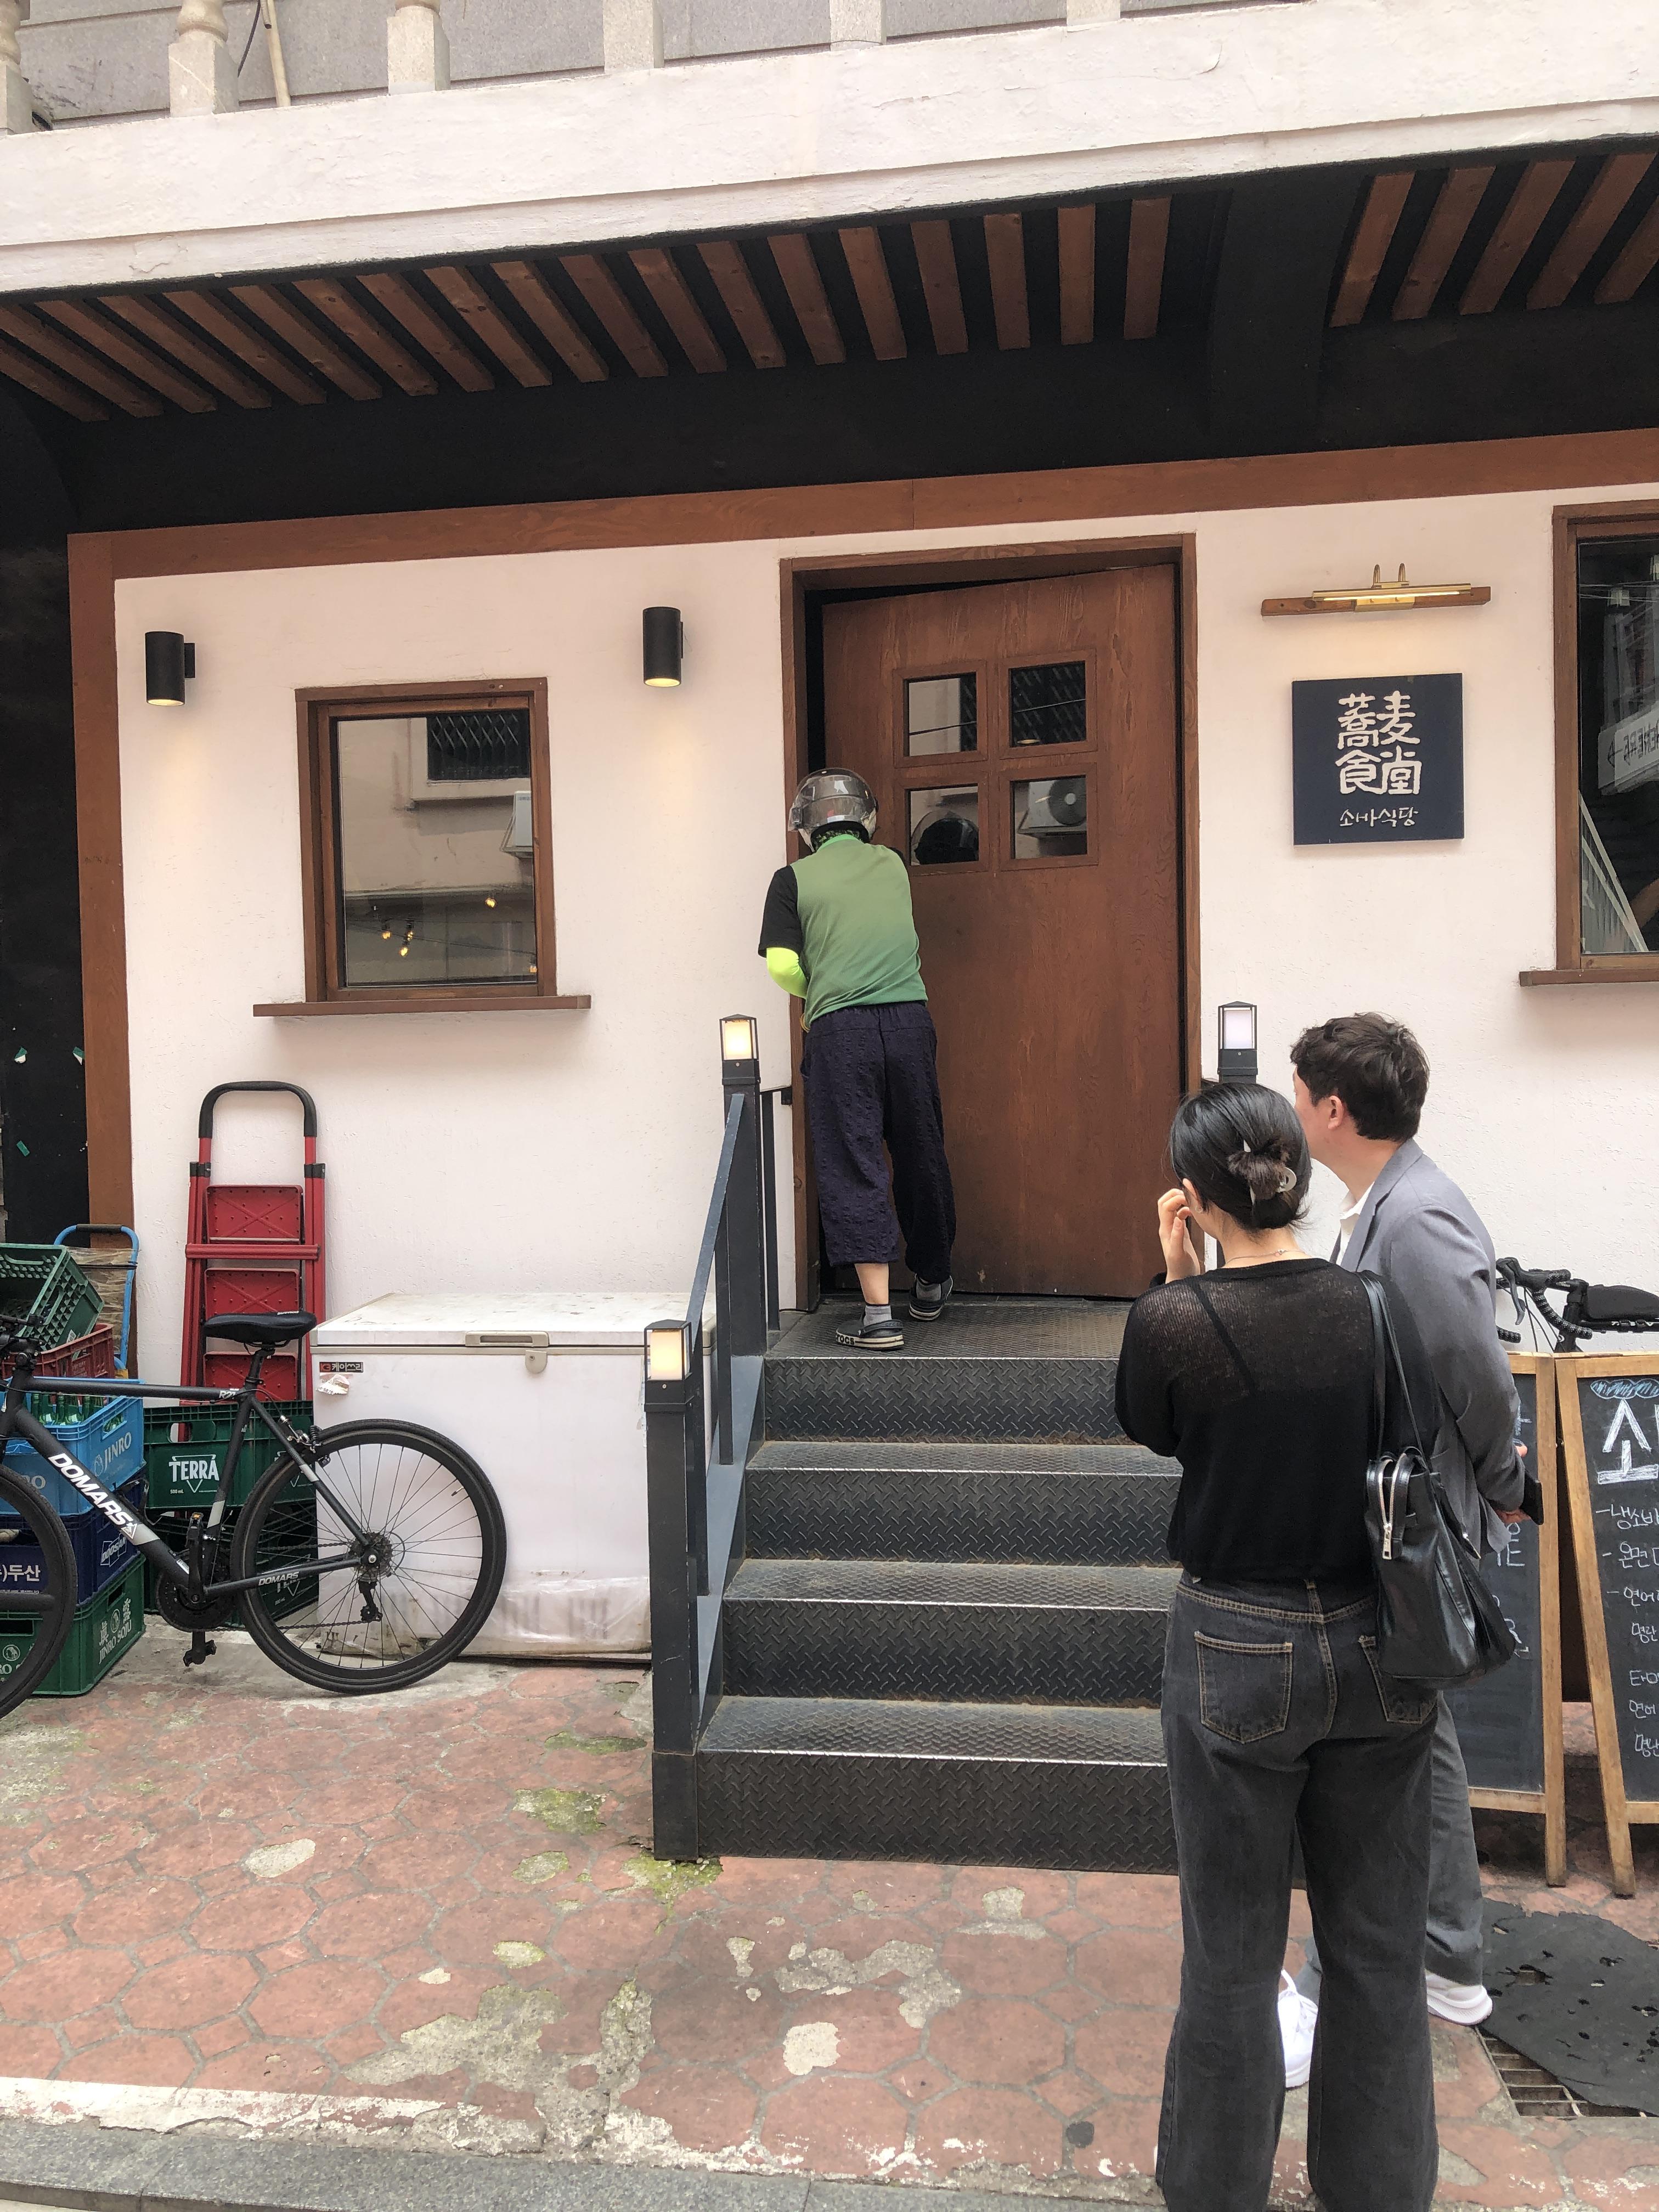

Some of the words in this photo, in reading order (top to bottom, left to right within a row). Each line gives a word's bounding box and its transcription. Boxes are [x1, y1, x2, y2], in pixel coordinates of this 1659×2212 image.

[1335, 745, 1423, 795] 食堂
[1339, 806, 1419, 827] 소바식당
[331, 1362, 363, 1372] 케이쓰리
[104, 1432, 132, 1472] JINRO
[1597, 1399, 1659, 1485] 소
[168, 1459, 219, 1482] TERRA
[48, 1453, 134, 1526] DOMARS
[0, 1564, 41, 1582] )두산
[258, 1571, 300, 1586] DOMARS
[1623, 1586, 1659, 1606] 연어
[99, 1636, 116, 1664] JINRO
[117, 1619, 132, 1643] SOJU
